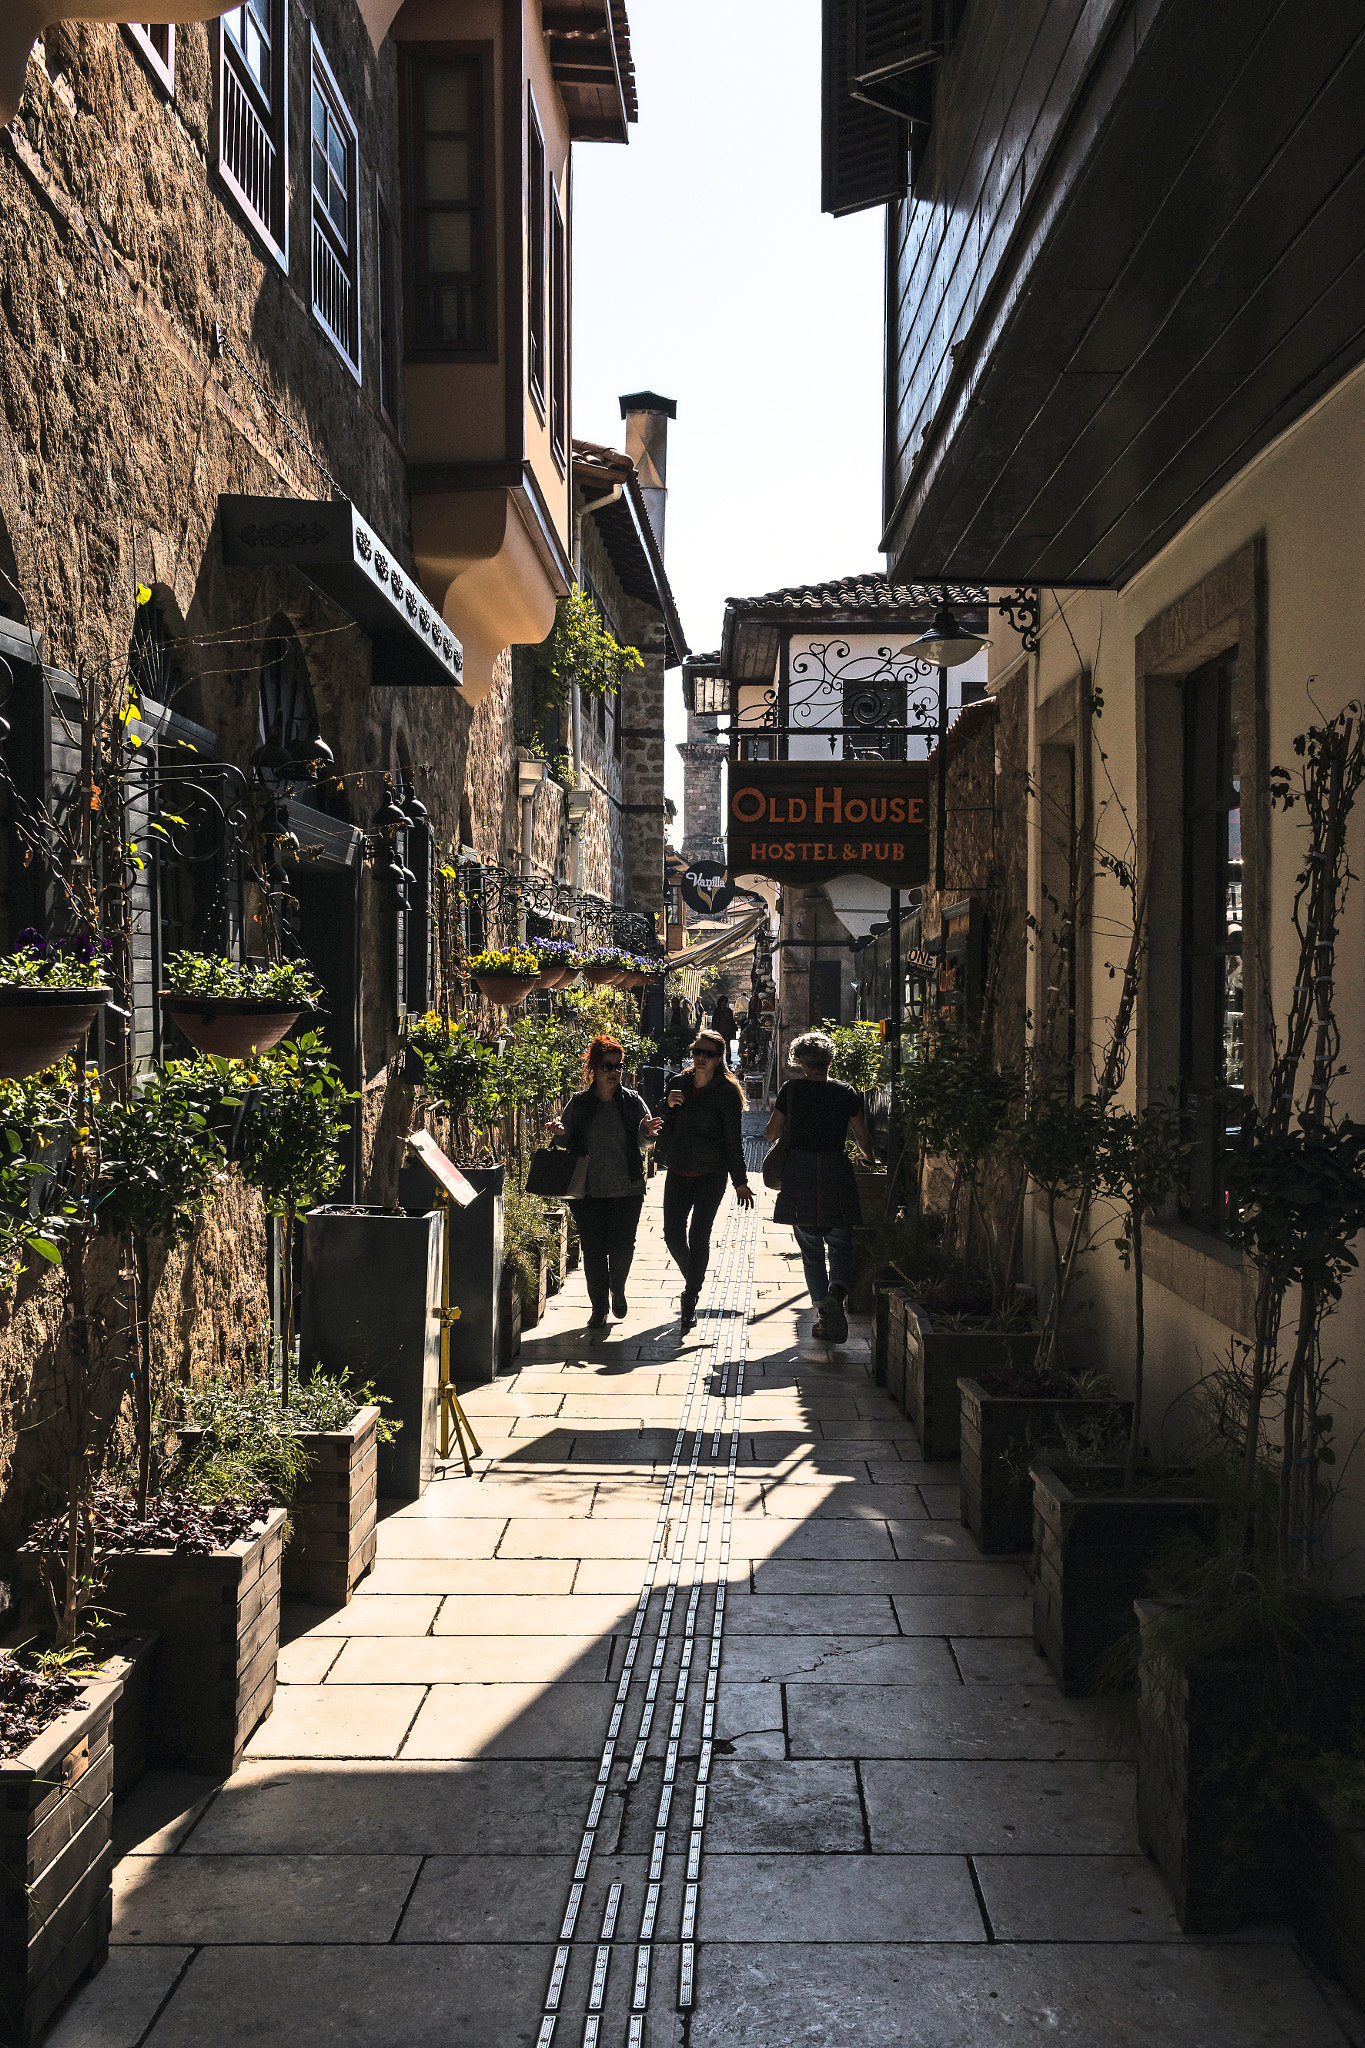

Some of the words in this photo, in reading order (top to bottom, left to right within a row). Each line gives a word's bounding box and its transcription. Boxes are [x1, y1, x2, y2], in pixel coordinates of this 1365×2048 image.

[731, 787, 807, 823] OLD
[814, 786, 925, 824] HOUSE
[751, 842, 838, 860] HOSTEL
[842, 843, 858, 861] &
[861, 842, 905, 861] PUB
[685, 872, 726, 891] Vanilla
[908, 949, 935, 967] ONE
